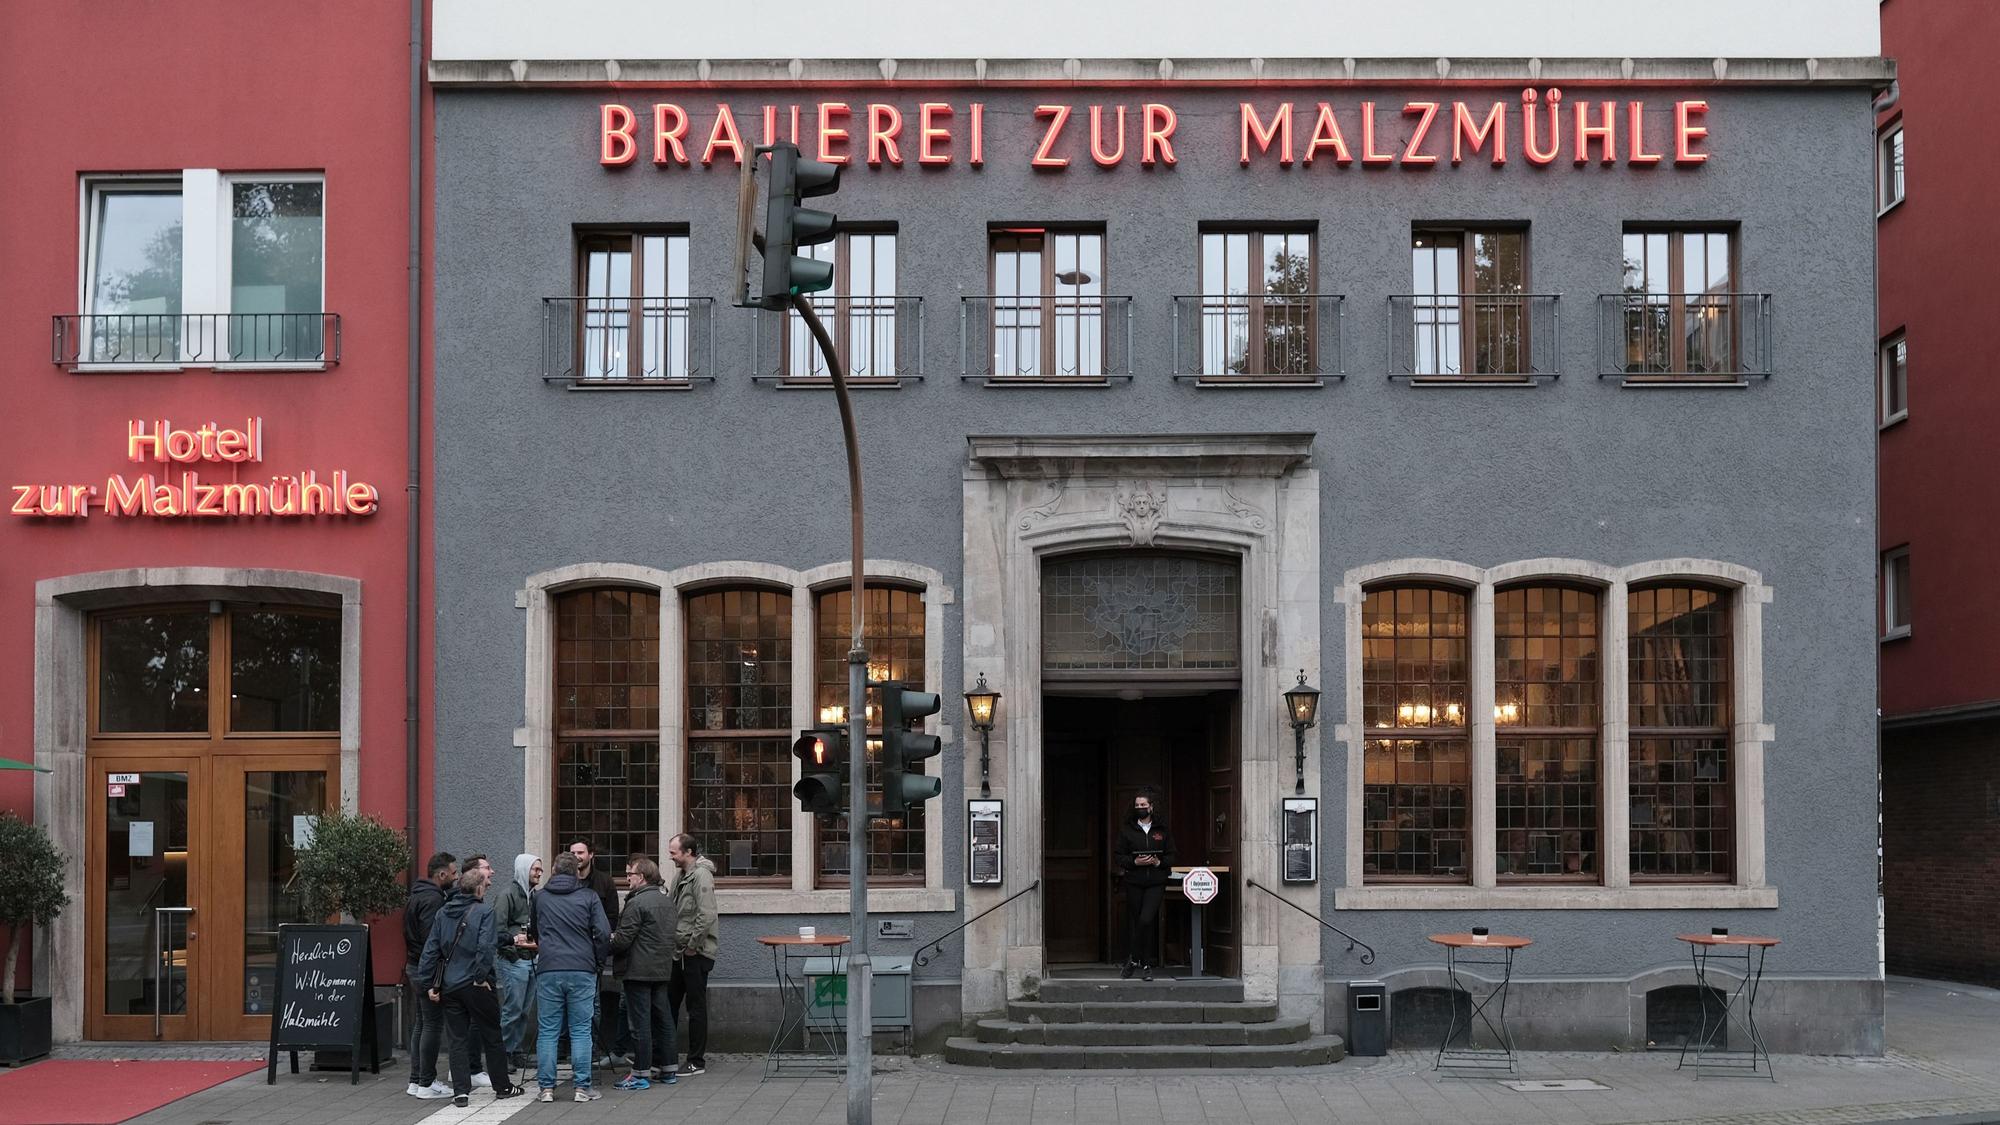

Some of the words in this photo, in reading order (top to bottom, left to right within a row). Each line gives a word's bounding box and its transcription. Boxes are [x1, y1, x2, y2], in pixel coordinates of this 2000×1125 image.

[599, 102, 984, 167] BRAUEREI
[1031, 102, 1178, 167] ZUR
[1239, 87, 1710, 165] MALZMÜHLE
[128, 416, 263, 463] Hotel
[11, 484, 97, 517] zur
[104, 469, 380, 517] Malzmühle
[291, 937, 335, 964] Herzlich
[295, 969, 356, 991] Willkommen
[315, 992, 324, 1001] in
[328, 989, 346, 1002] der
[280, 1001, 341, 1029] Malzmühle
